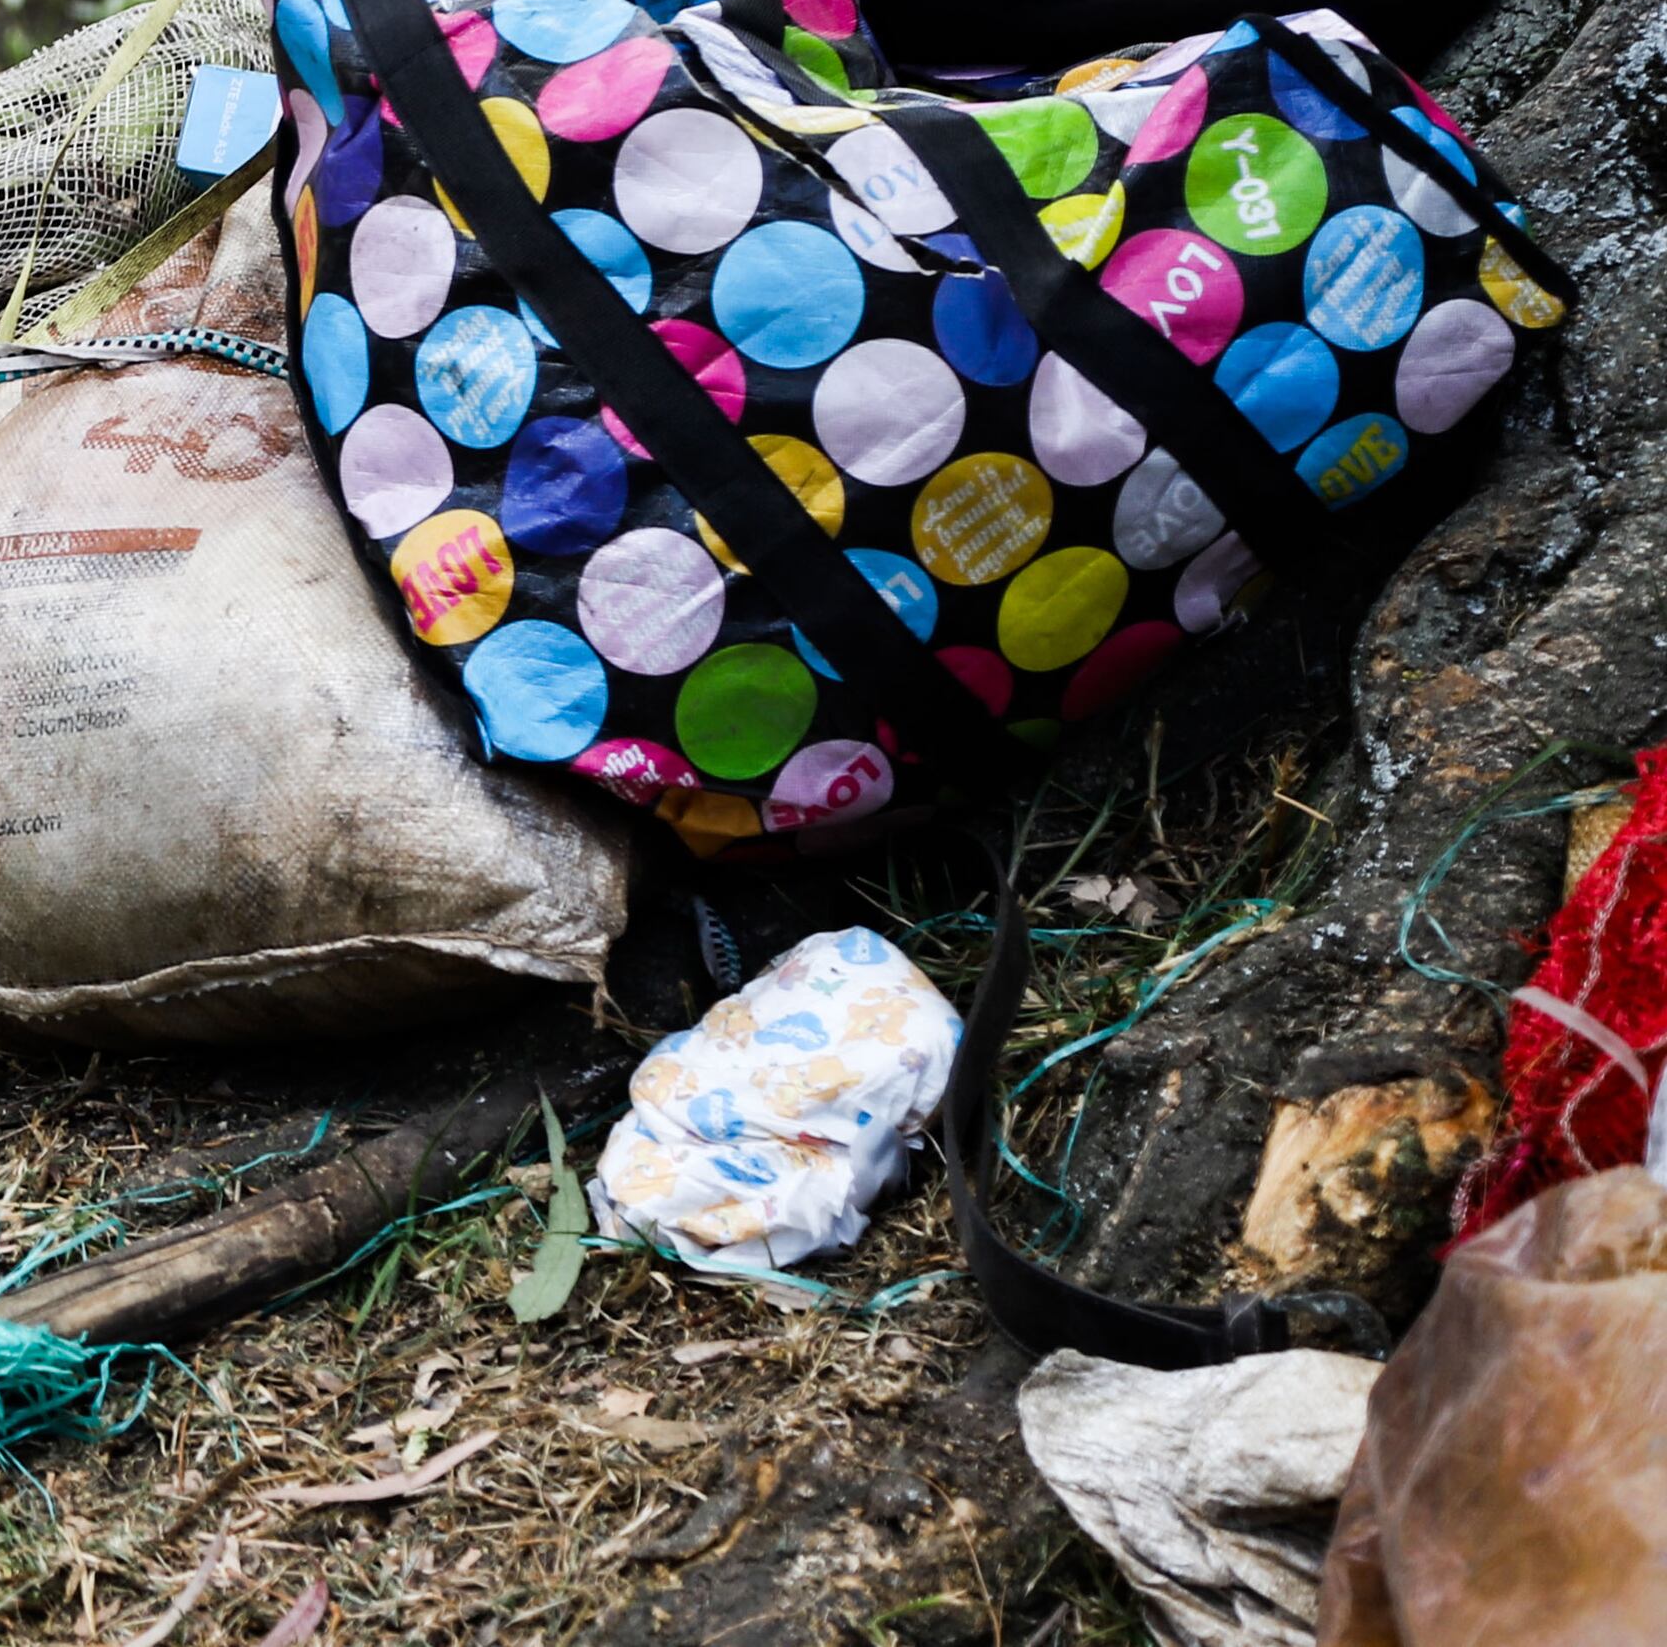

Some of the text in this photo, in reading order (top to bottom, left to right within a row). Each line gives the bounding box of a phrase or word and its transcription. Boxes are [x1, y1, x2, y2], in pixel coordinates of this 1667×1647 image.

[231, 77, 244, 101] ZTE
[1220, 128, 1283, 240] Y-031
[1148, 241, 1223, 340] LOV
[1321, 422, 1401, 504] OVE
[402, 523, 504, 635] LOVE
